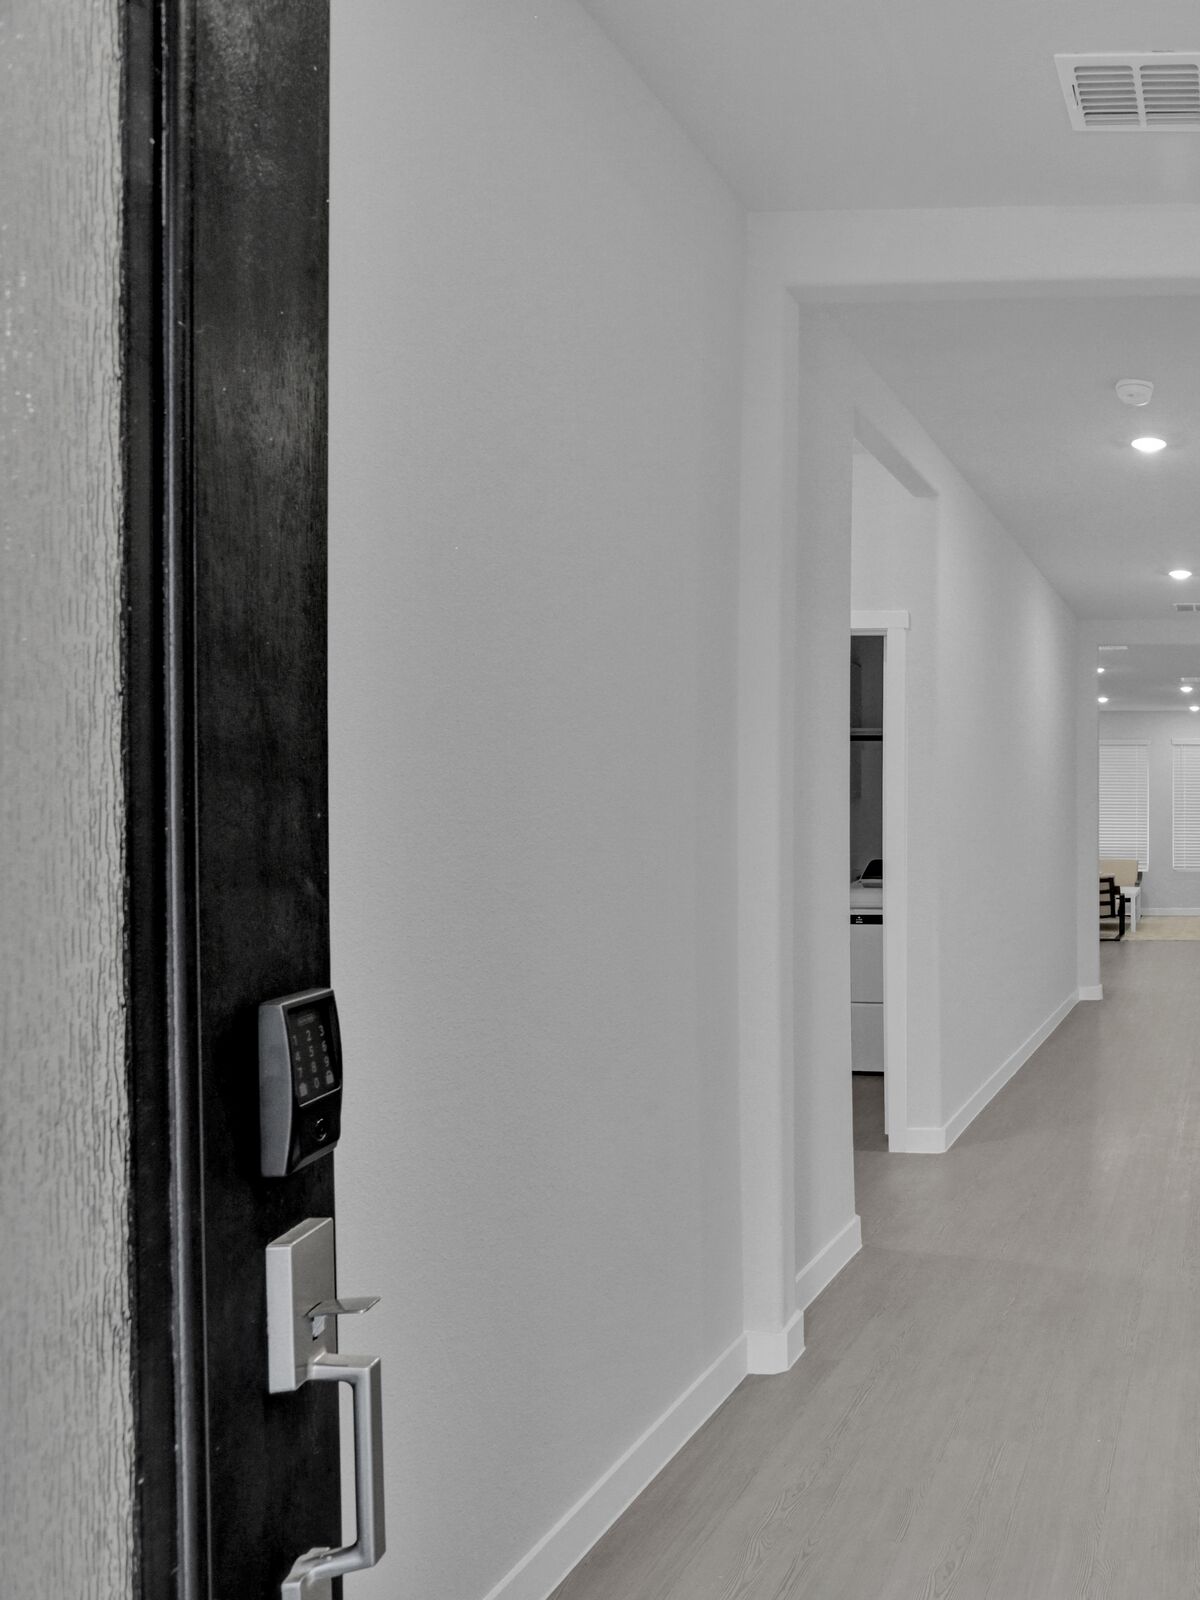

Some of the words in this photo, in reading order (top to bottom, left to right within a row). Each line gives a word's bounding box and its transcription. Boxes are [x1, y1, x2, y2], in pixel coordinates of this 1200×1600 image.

[292, 1034, 298, 1046] 1
[306, 1029, 312, 1042] 2
[318, 1024, 325, 1037] 3
[295, 1050, 301, 1062] 4
[309, 1044, 314, 1058] 5
[321, 1040, 328, 1052] 6
[297, 1066, 303, 1079] 7
[311, 1060, 317, 1073] 8
[323, 1055, 330, 1067] 9
[313, 1076, 320, 1089] 0
